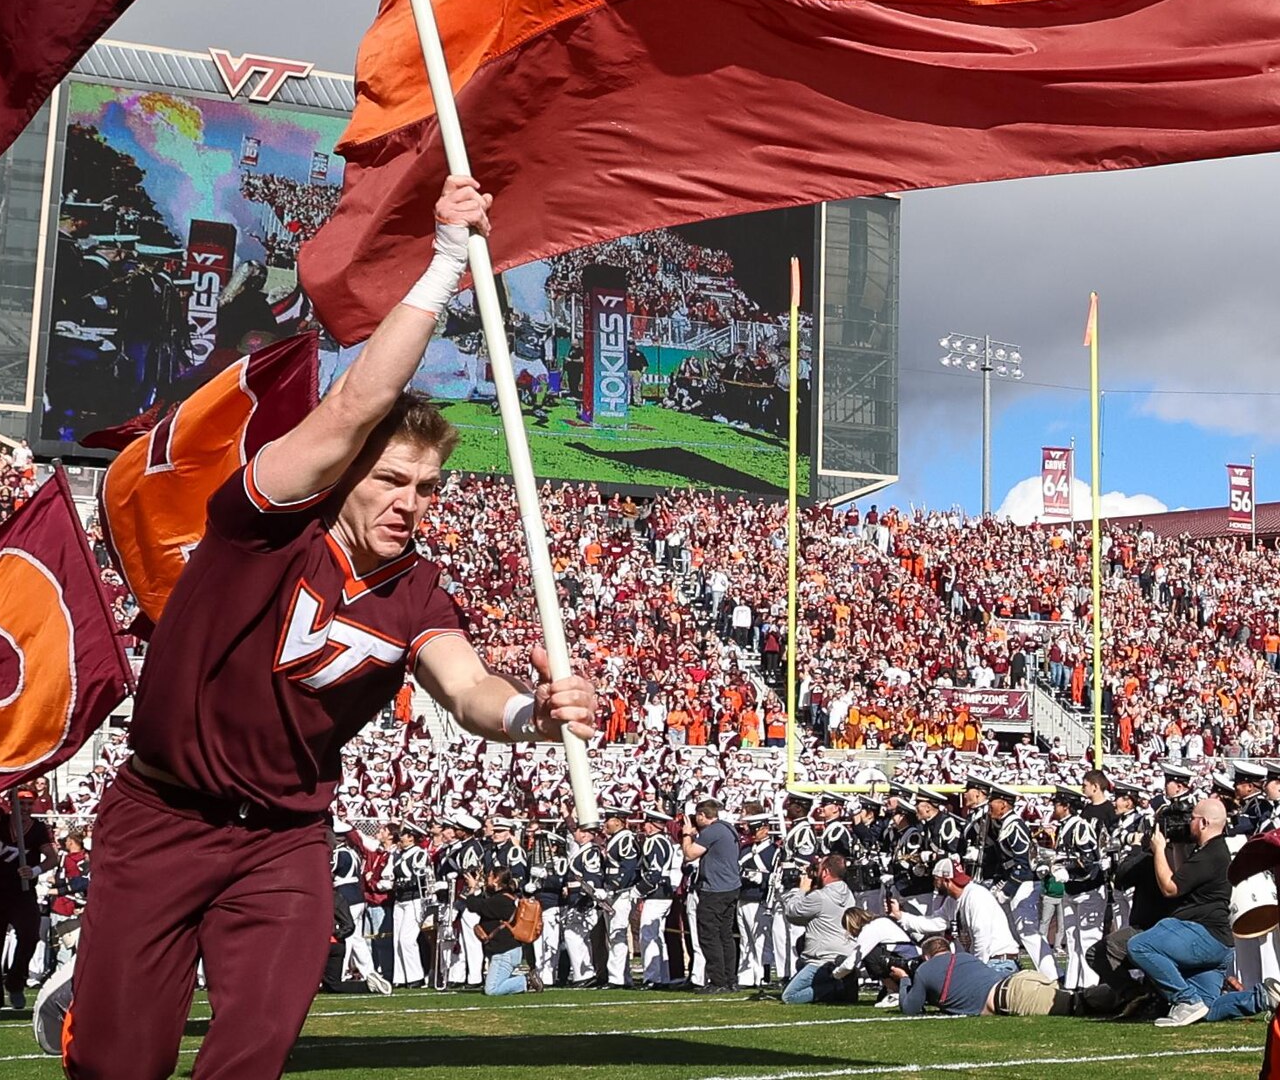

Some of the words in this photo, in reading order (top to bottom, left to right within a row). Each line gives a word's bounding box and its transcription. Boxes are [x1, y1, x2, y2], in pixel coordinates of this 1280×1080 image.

[208, 47, 315, 102] VT
[192, 252, 223, 266] VT
[185, 271, 220, 366] OKIES
[597, 294, 624, 307] VT
[599, 313, 627, 417] HOKIES
[1044, 475, 1069, 497] 64
[1231, 489, 1252, 512] 56
[273, 577, 407, 693] VT
